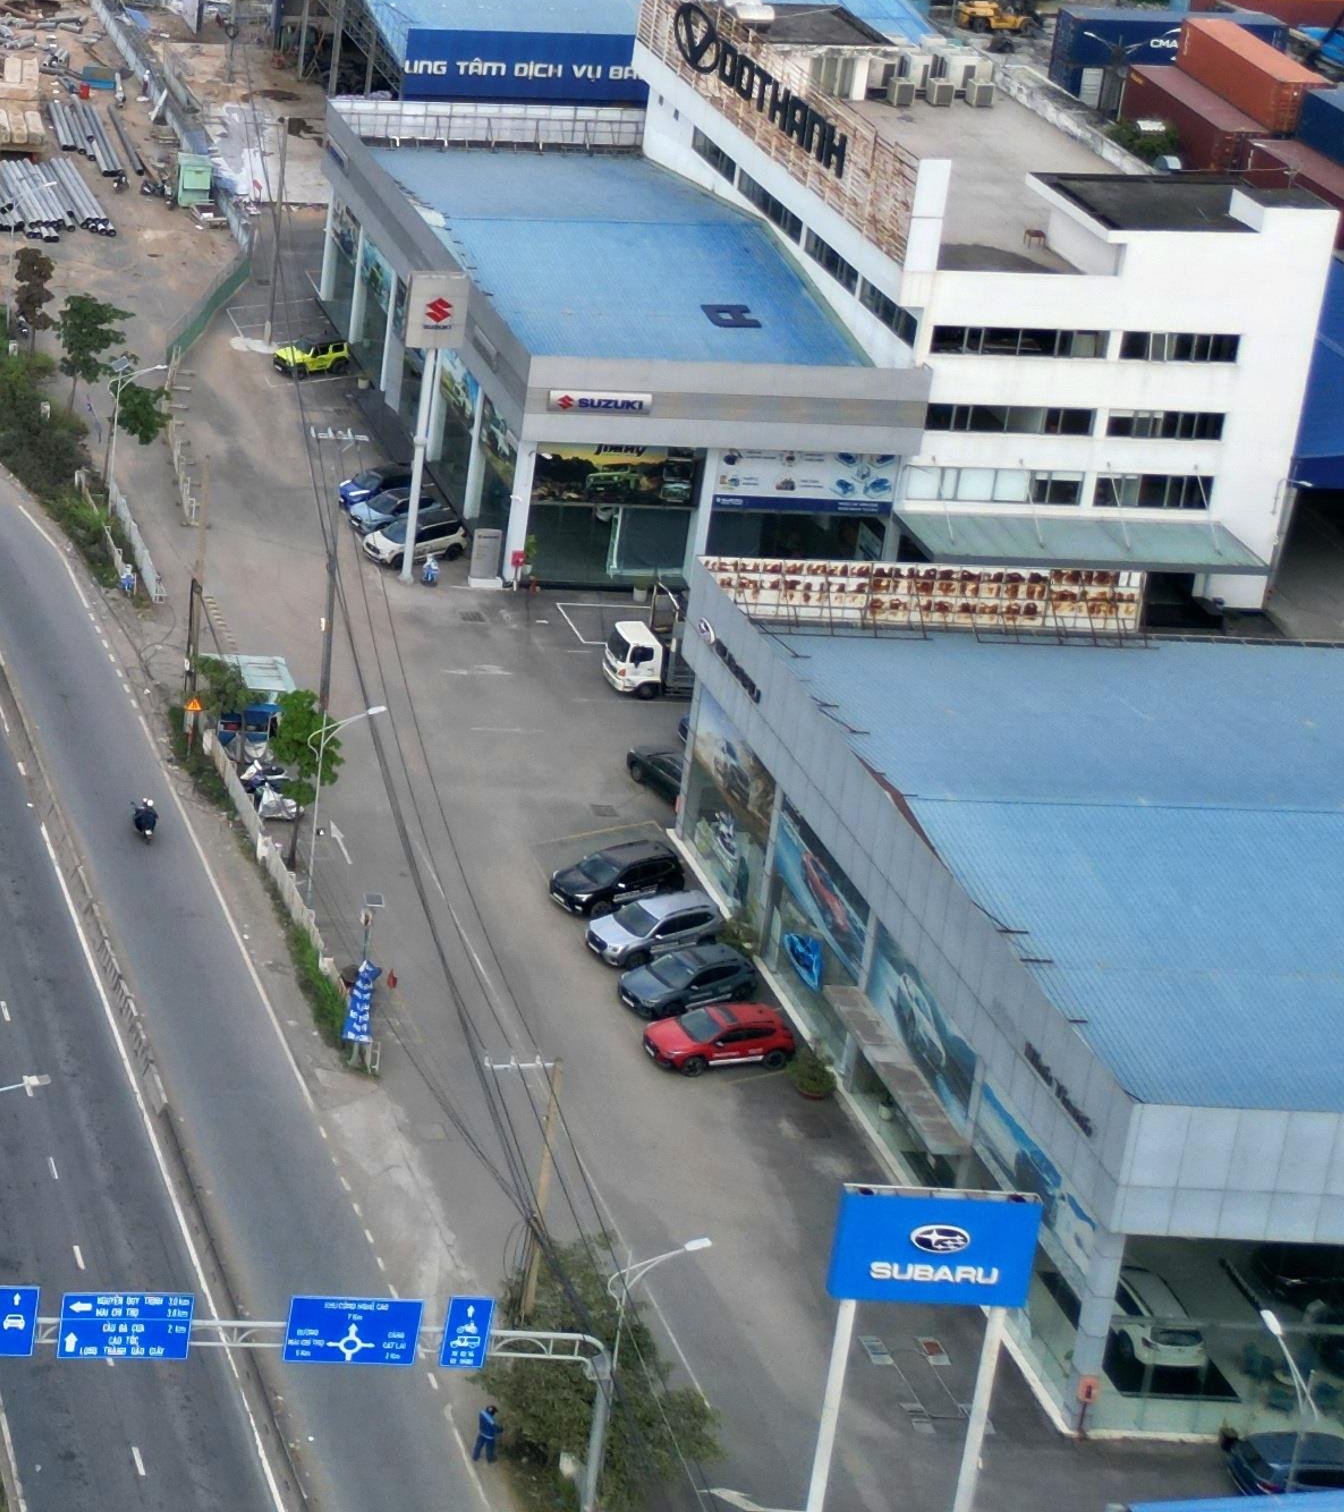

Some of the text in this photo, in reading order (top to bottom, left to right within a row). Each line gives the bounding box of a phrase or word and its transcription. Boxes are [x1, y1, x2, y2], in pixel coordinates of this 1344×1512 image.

[1149, 38, 1178, 49] CMA
[577, 397, 644, 411] SUZUKI
[869, 1261, 1000, 1286] SUBARU
